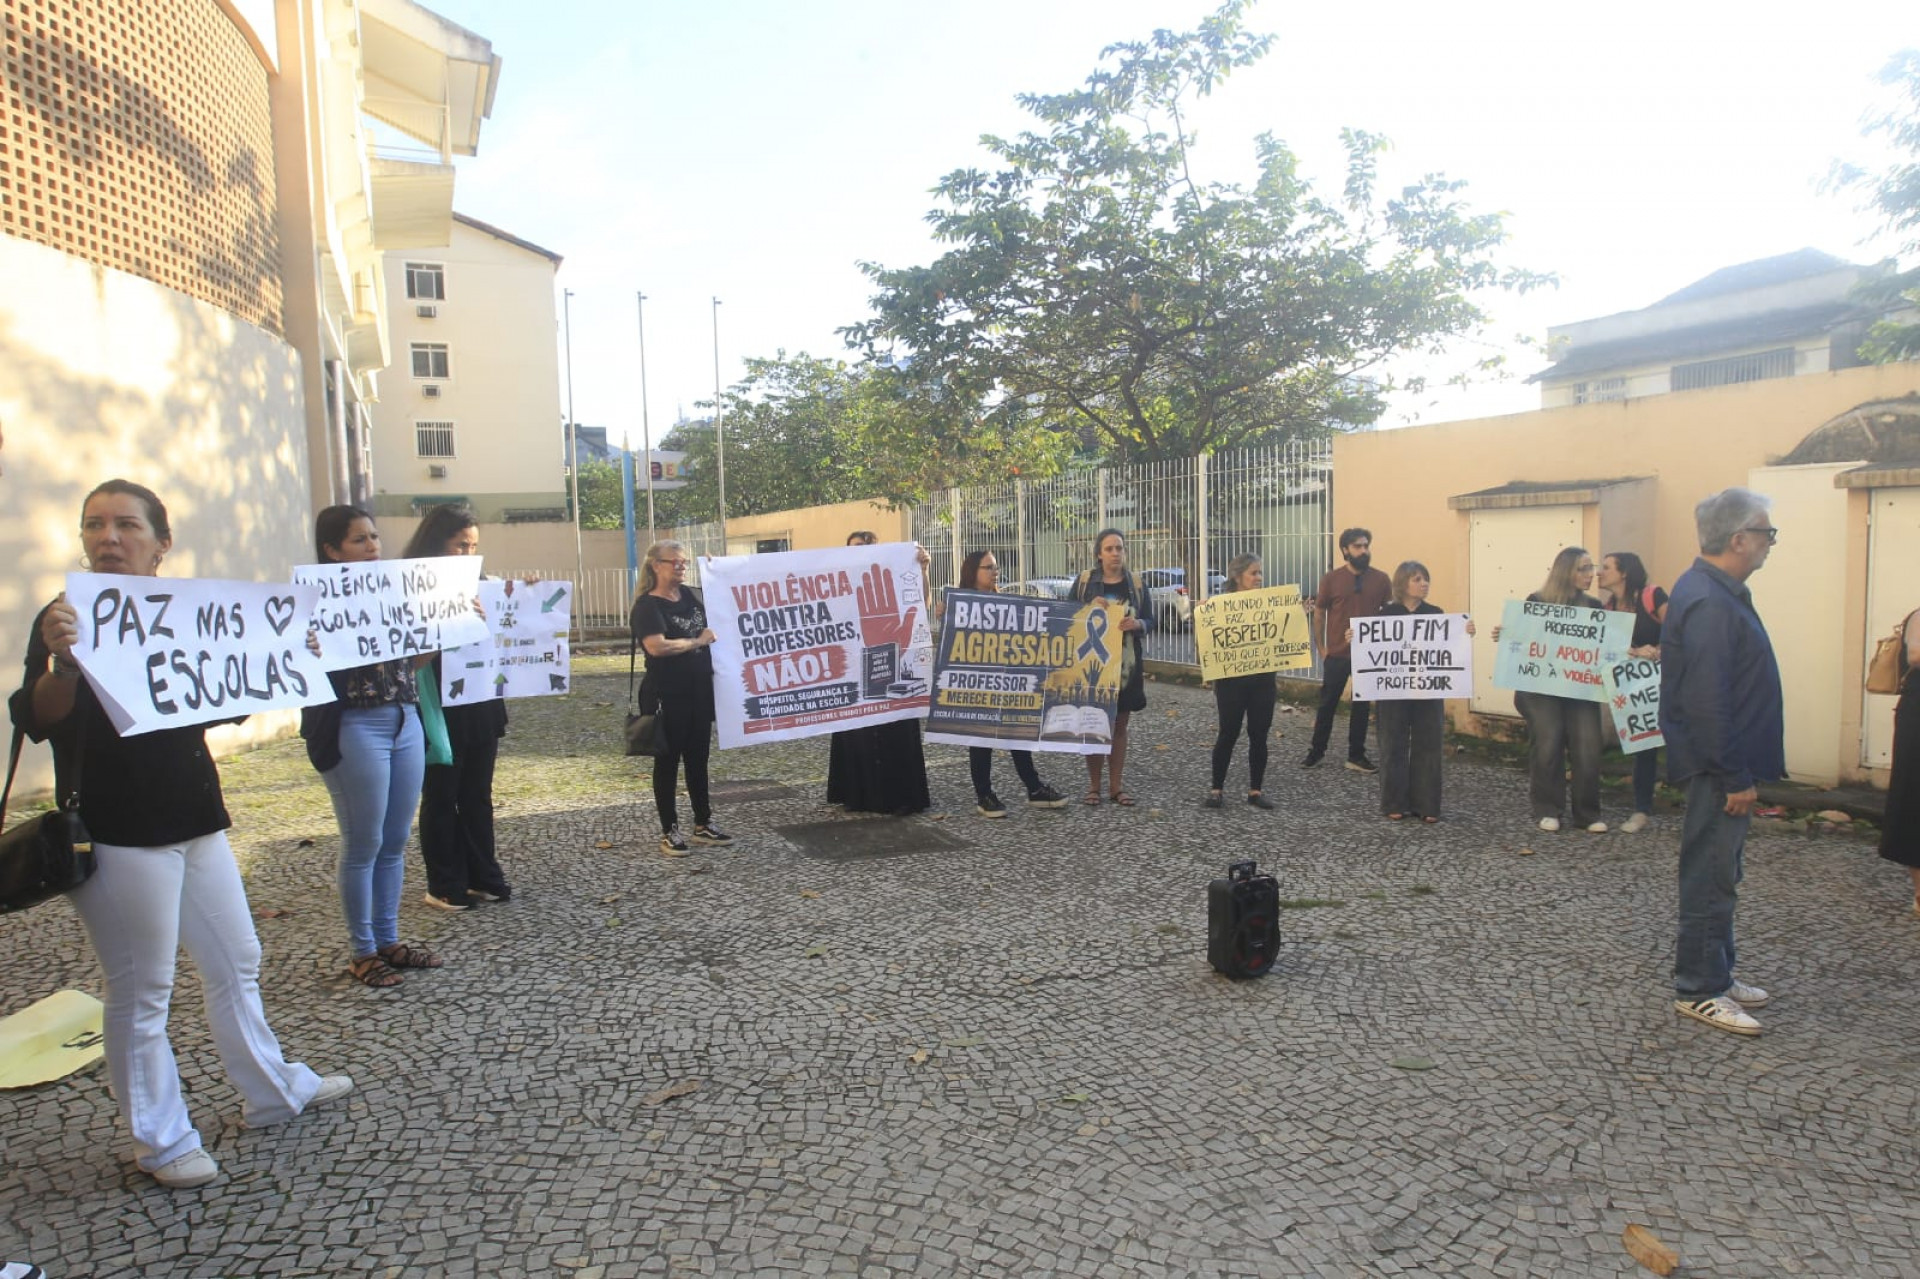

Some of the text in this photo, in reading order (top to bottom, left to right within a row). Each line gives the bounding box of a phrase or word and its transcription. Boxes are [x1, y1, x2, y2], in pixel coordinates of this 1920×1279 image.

[295, 564, 437, 599] OLÊNCIA NÃO
[731, 570, 853, 612] VIOLÊNCIA
[93, 588, 245, 652] PAZ NAS
[309, 608, 371, 634] SCOLA
[380, 601, 414, 627] LINS
[420, 592, 468, 623] LUGAR
[738, 601, 832, 637] CONTRA
[954, 601, 1050, 632] BASTA DE
[1253, 610, 1275, 622] COM
[1523, 603, 1606, 622] RESPEITO AO
[357, 624, 442, 657] DE PAZ!
[741, 621, 861, 657] PROFESSORES,
[1212, 612, 1290, 648] RESPEITO!
[1359, 619, 1449, 643] PELO FIM
[1545, 621, 1605, 643] PROFESSOR!
[950, 631, 1074, 667] AGRESSÃO!
[1212, 651, 1237, 663] TUDO
[1240, 648, 1260, 660] QUE
[1263, 646, 1270, 656] O
[1529, 642, 1546, 658] EU
[1556, 646, 1600, 666] APOIO!
[147, 649, 309, 715] ESCOLAS
[753, 651, 832, 692] NÃO!
[949, 673, 1028, 692] PROFESSOR
[1377, 676, 1452, 691] PROFESSOR
[1518, 662, 1604, 685] NÃO À VIOLÊNC
[1612, 661, 1661, 687] PROF
[797, 687, 838, 700] SEGURANÇA
[946, 691, 1035, 708] MERECE RESPEITO
[1630, 685, 1659, 707] ME
[760, 696, 850, 716] DIGNIDADE NA ESCOLA
[795, 711, 838, 725] PROFESSORES
[1627, 712, 1657, 734] RE
